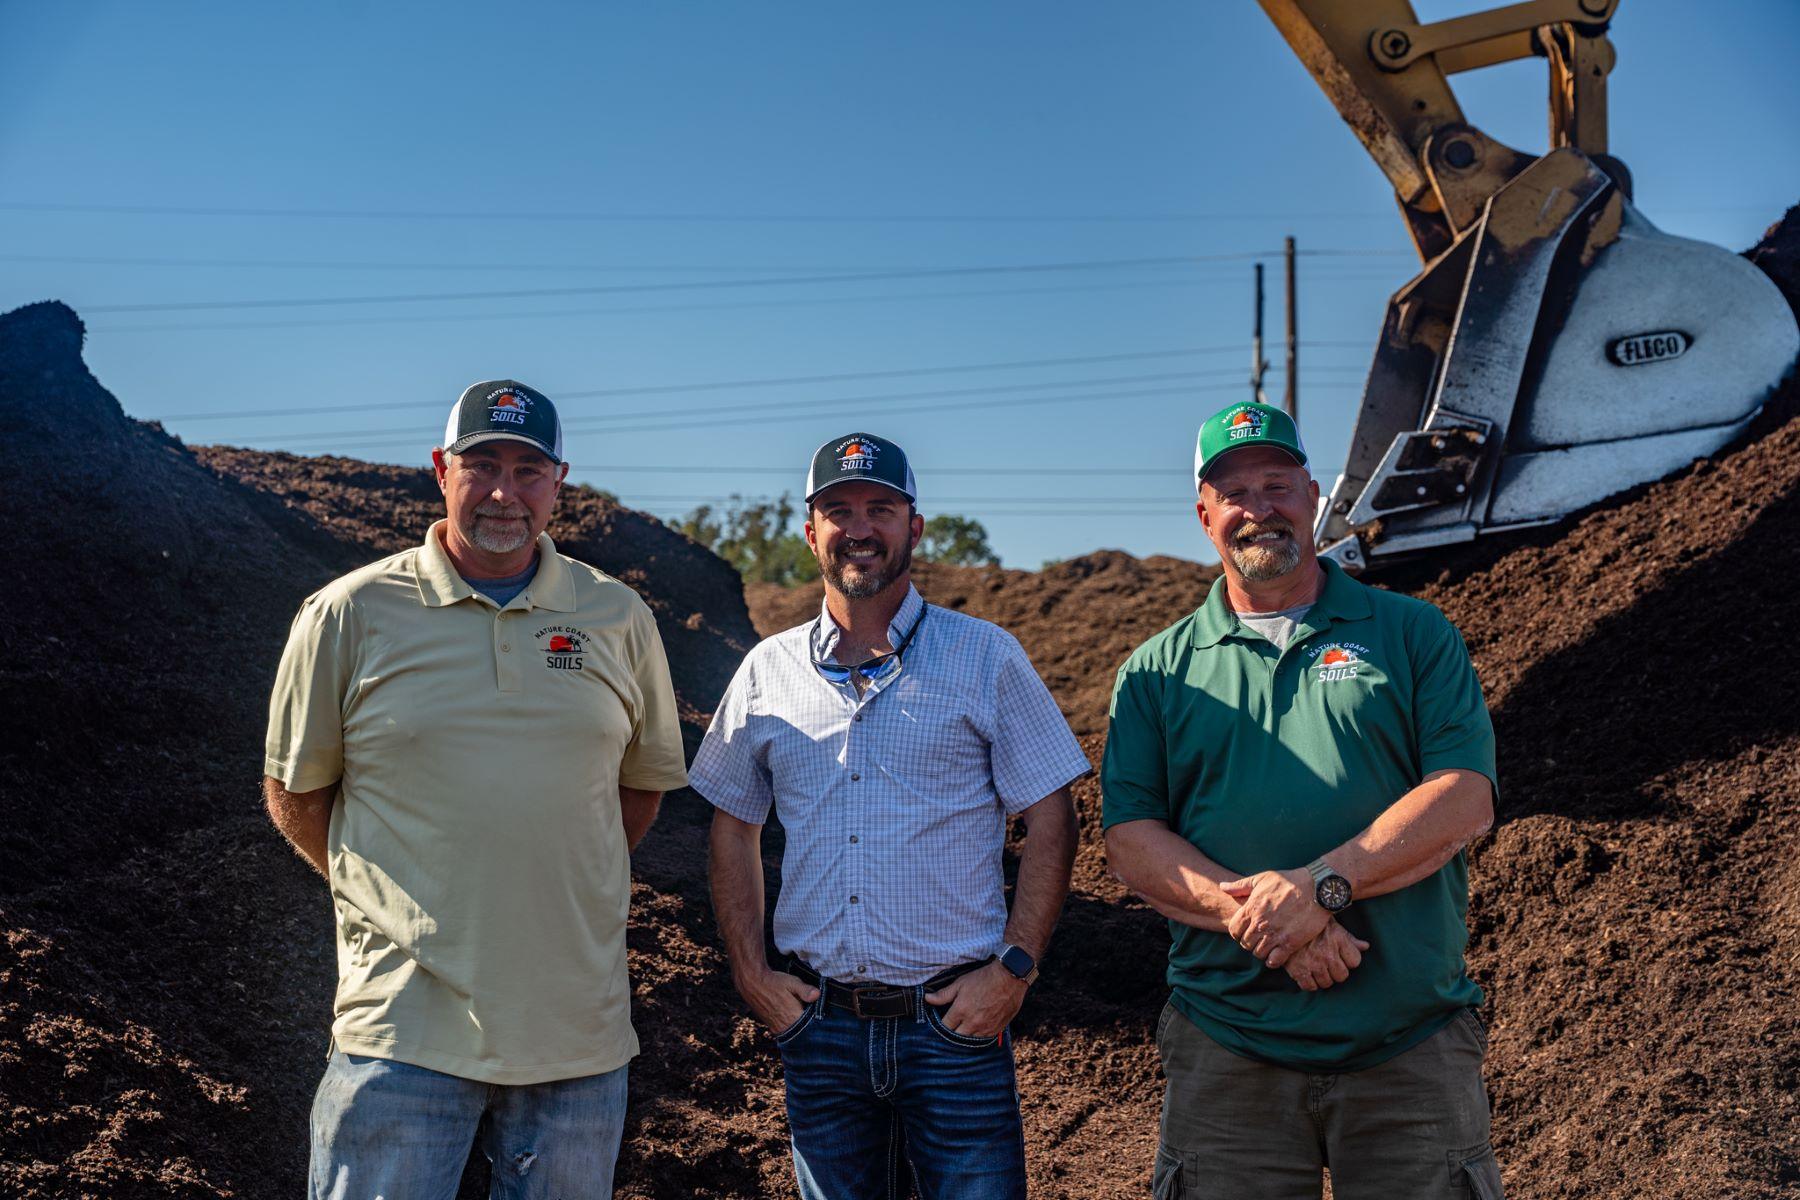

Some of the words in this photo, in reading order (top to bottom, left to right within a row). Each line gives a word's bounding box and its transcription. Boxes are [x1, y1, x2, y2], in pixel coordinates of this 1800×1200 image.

[1625, 336, 1679, 361] FLECO
[490, 411, 525, 424] SOILS
[1230, 427, 1261, 440] SOILS
[840, 460, 873, 471] SOILS
[534, 626, 563, 640] NATURE
[565, 626, 591, 643] COAST
[1308, 642, 1341, 658] NATURE
[1343, 642, 1370, 654] COAST
[546, 656, 583, 670] SOILS
[1318, 667, 1357, 682] SOILS
